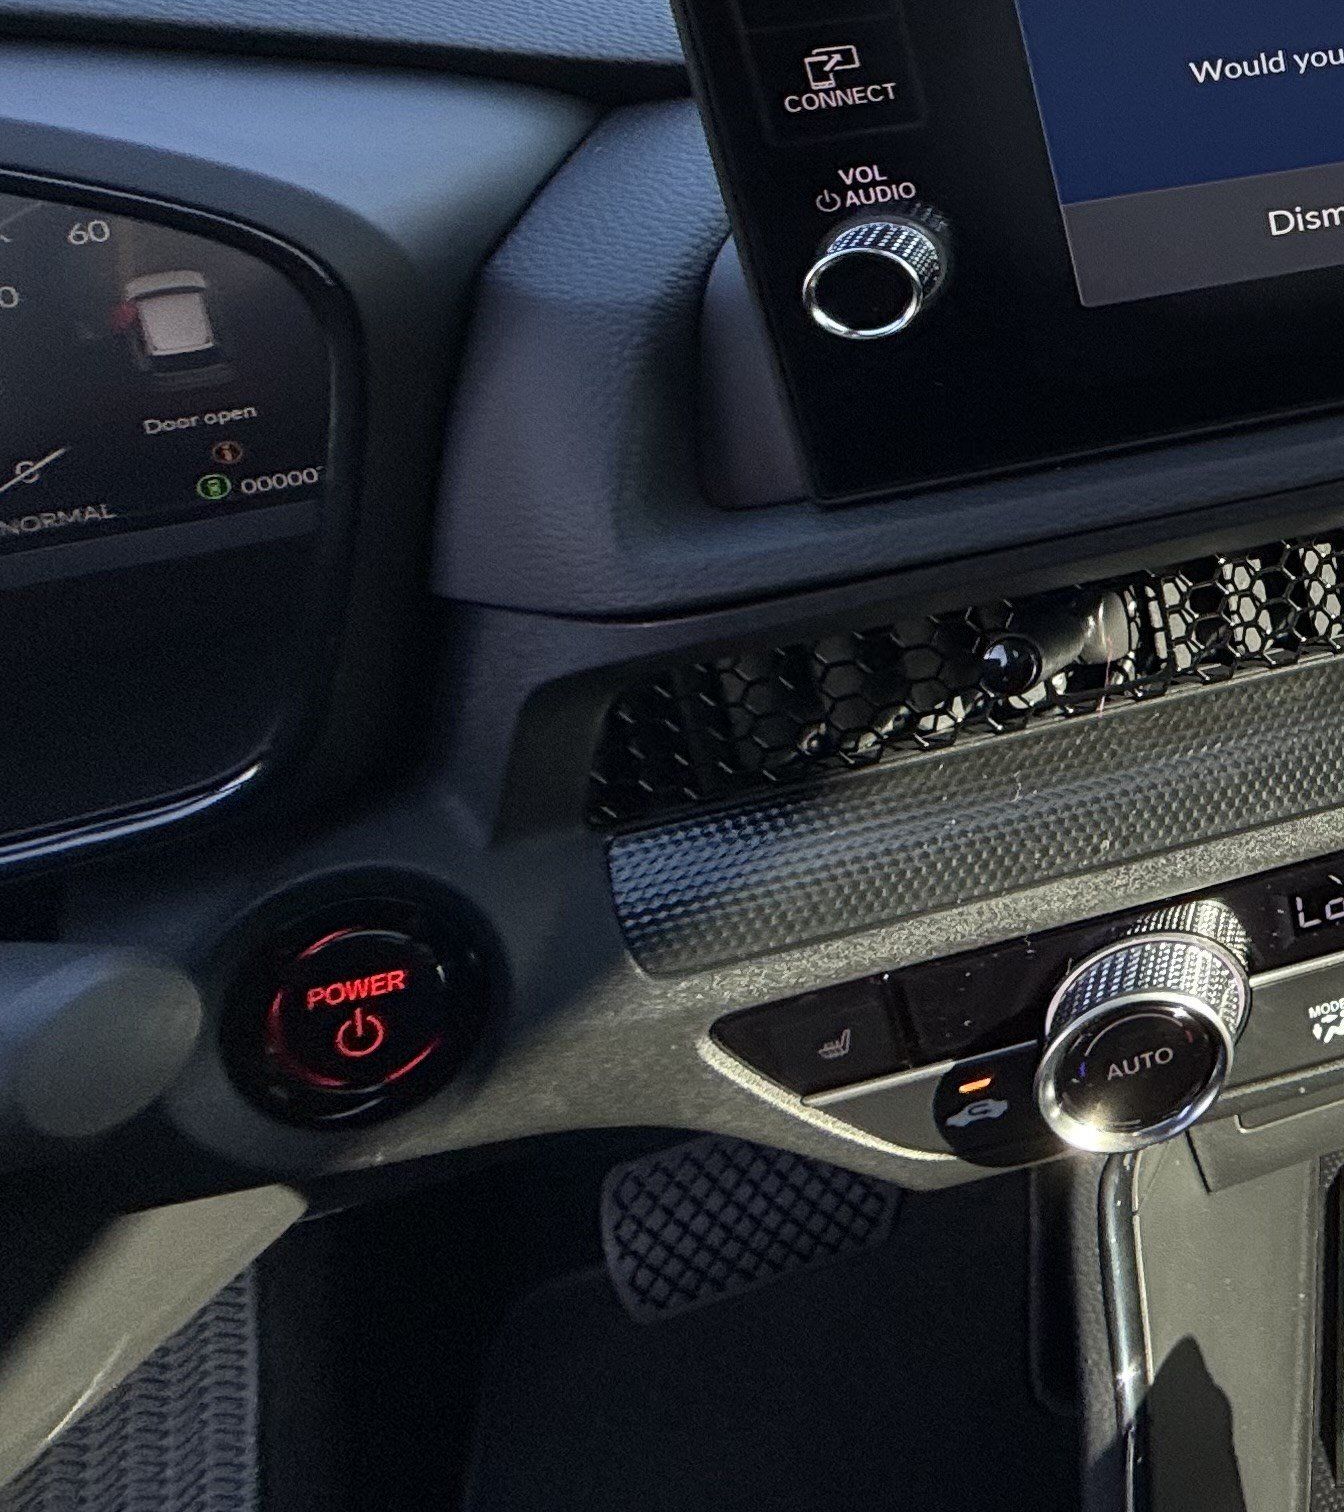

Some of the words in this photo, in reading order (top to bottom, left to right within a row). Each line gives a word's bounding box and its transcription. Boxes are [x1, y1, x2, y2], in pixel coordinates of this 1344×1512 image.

[1189, 50, 1286, 83] Would
[1293, 47, 1344, 74] you
[784, 82, 896, 113] CONNECT
[837, 165, 888, 185] VOL
[845, 181, 916, 208] AUDIO
[68, 220, 110, 245] 60
[143, 415, 199, 435] Door
[204, 406, 257, 426] open
[241, 467, 319, 494] 00000
[0, 504, 117, 536] NORMAL
[307, 970, 405, 1010] POWER
[1107, 1047, 1174, 1081] AUTO
